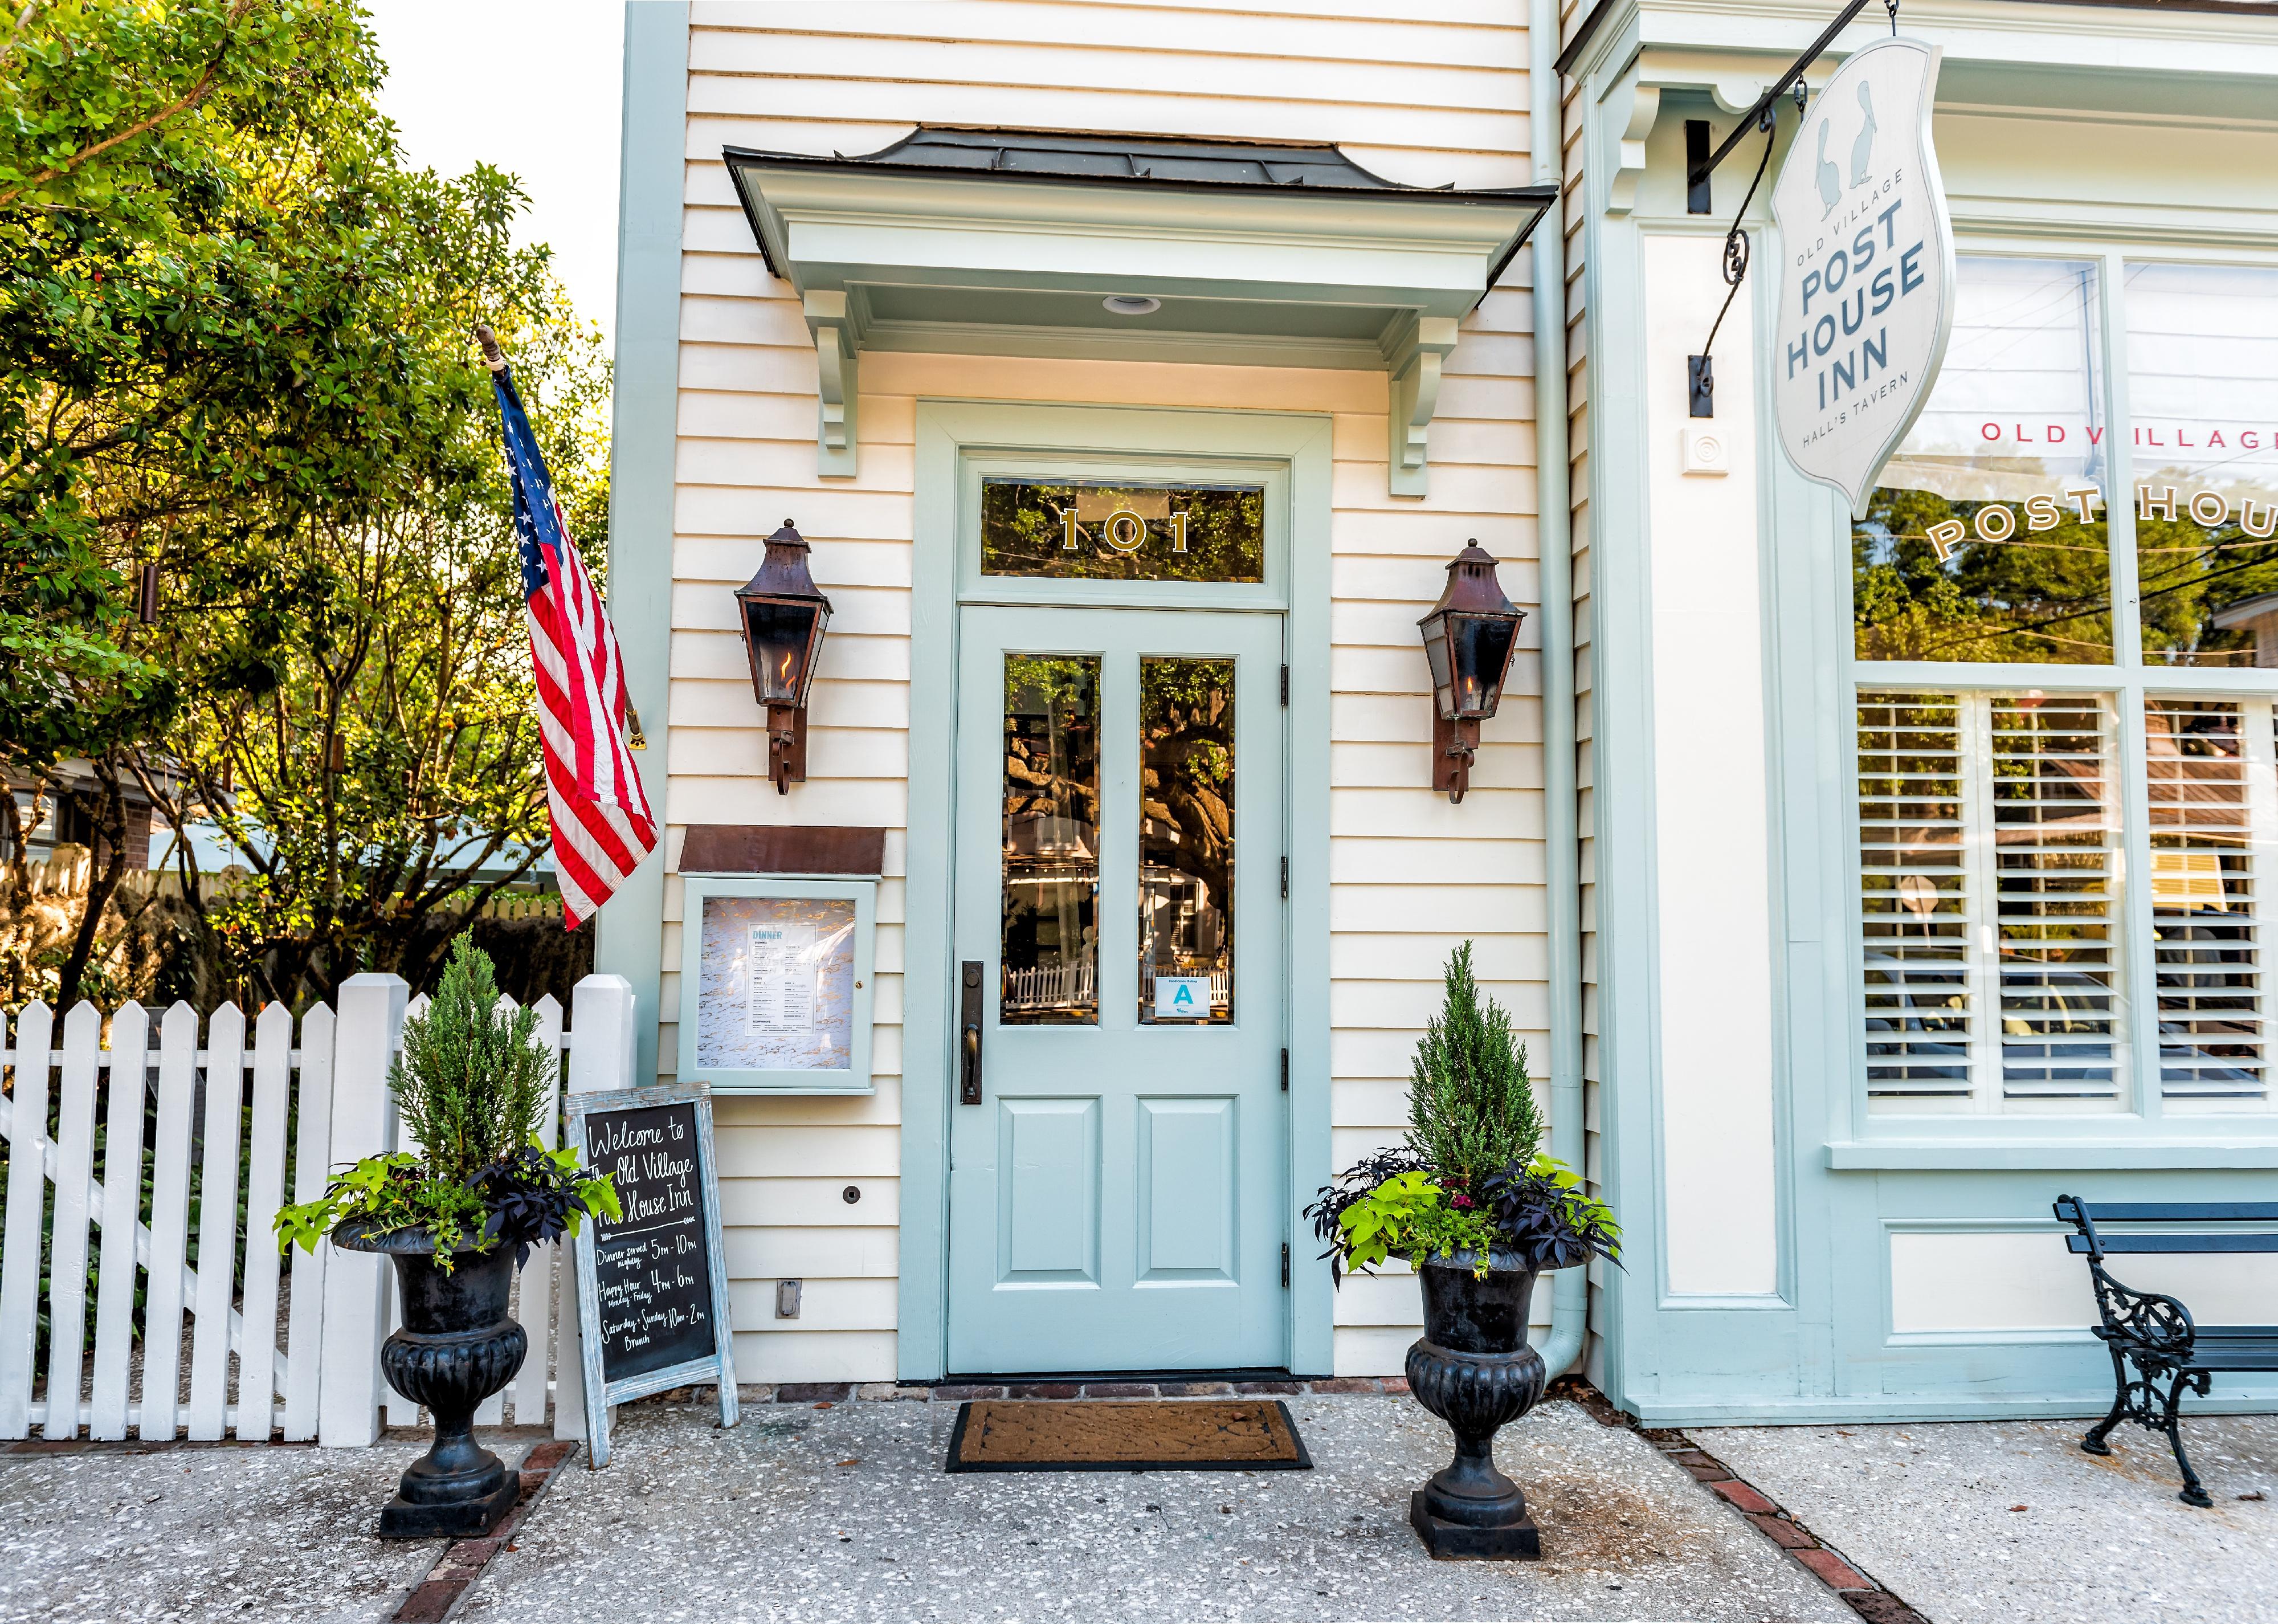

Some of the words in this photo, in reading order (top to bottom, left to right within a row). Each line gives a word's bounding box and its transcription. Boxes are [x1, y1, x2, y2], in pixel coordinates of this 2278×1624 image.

[1797, 237, 1824, 267] OLD
[1833, 168, 1903, 235] VILLAGE
[1801, 198, 1902, 318] POST
[1787, 239, 1924, 381] HOUSE
[1818, 326, 1887, 413] INN
[1803, 411, 1847, 448] HALL'S
[1853, 371, 1908, 415] TAVERN
[1981, 422, 2066, 444] OLD
[2086, 425, 2278, 450] VILLAG
[1059, 508, 1188, 553] 101
[1925, 484, 2101, 564] POST
[753, 931, 782, 940] DINNER
[1173, 984, 1194, 1004] A
[589, 1120, 664, 1158] Welcome
[668, 1116, 684, 1141] to
[617, 1154, 639, 1186] Old
[642, 1152, 693, 1188] Village
[627, 1190, 667, 1223] House
[667, 1183, 693, 1211] Inn
[597, 1249, 625, 1266] Dinner
[627, 1242, 648, 1256] served
[618, 1257, 642, 1271] nightly
[598, 1280, 623, 1302] Happy
[623, 1275, 641, 1294] Hour
[608, 1296, 630, 1308] Monday
[633, 1291, 652, 1304] Friday
[602, 1318, 637, 1344] Saturday
[642, 1308, 668, 1331] Sunday
[624, 1335, 650, 1352] Brunch
